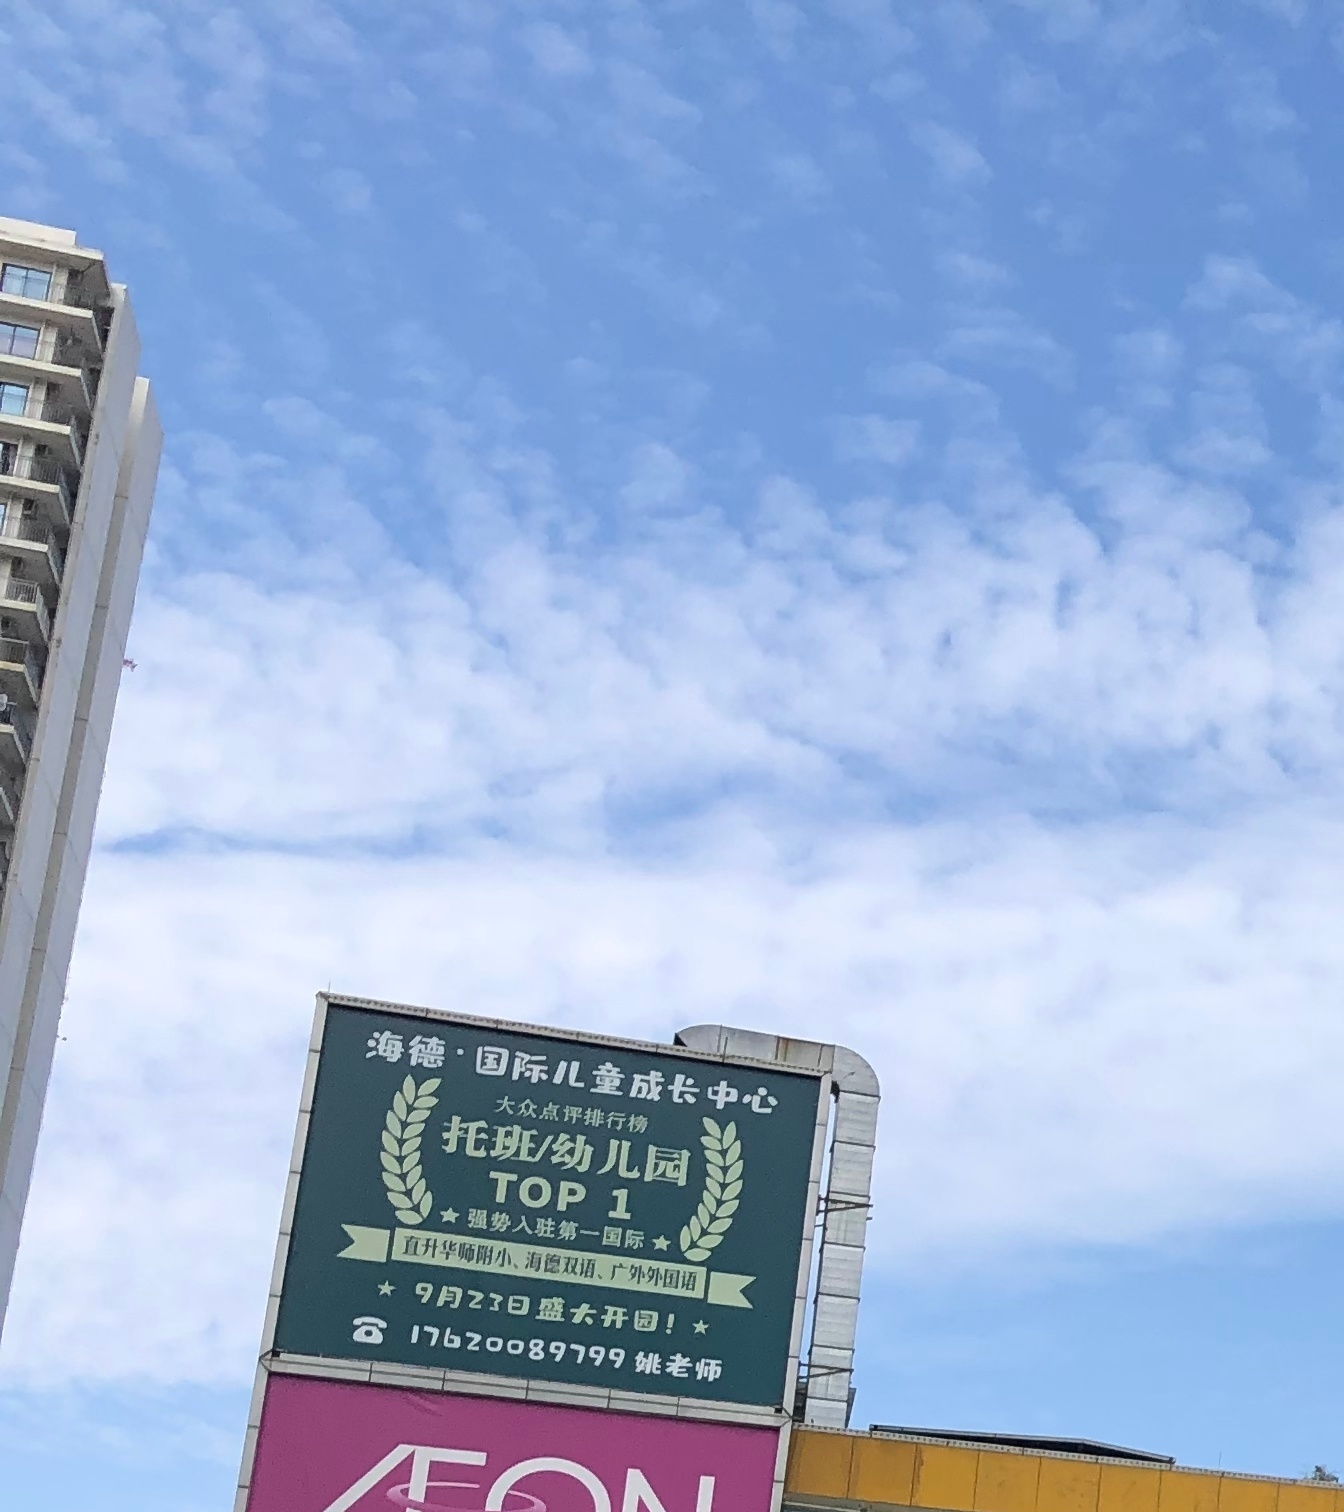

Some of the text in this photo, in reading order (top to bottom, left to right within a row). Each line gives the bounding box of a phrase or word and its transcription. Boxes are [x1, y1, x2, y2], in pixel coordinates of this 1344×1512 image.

[495, 1096, 650, 1134] 大众点评排行榜
[441, 1114, 691, 1187] 托班/幼儿园
[489, 1171, 632, 1220] TOP 1
[468, 1208, 646, 1250] 强势入驻第一国际
[410, 1324, 723, 1383] 17620089799 姚老师
